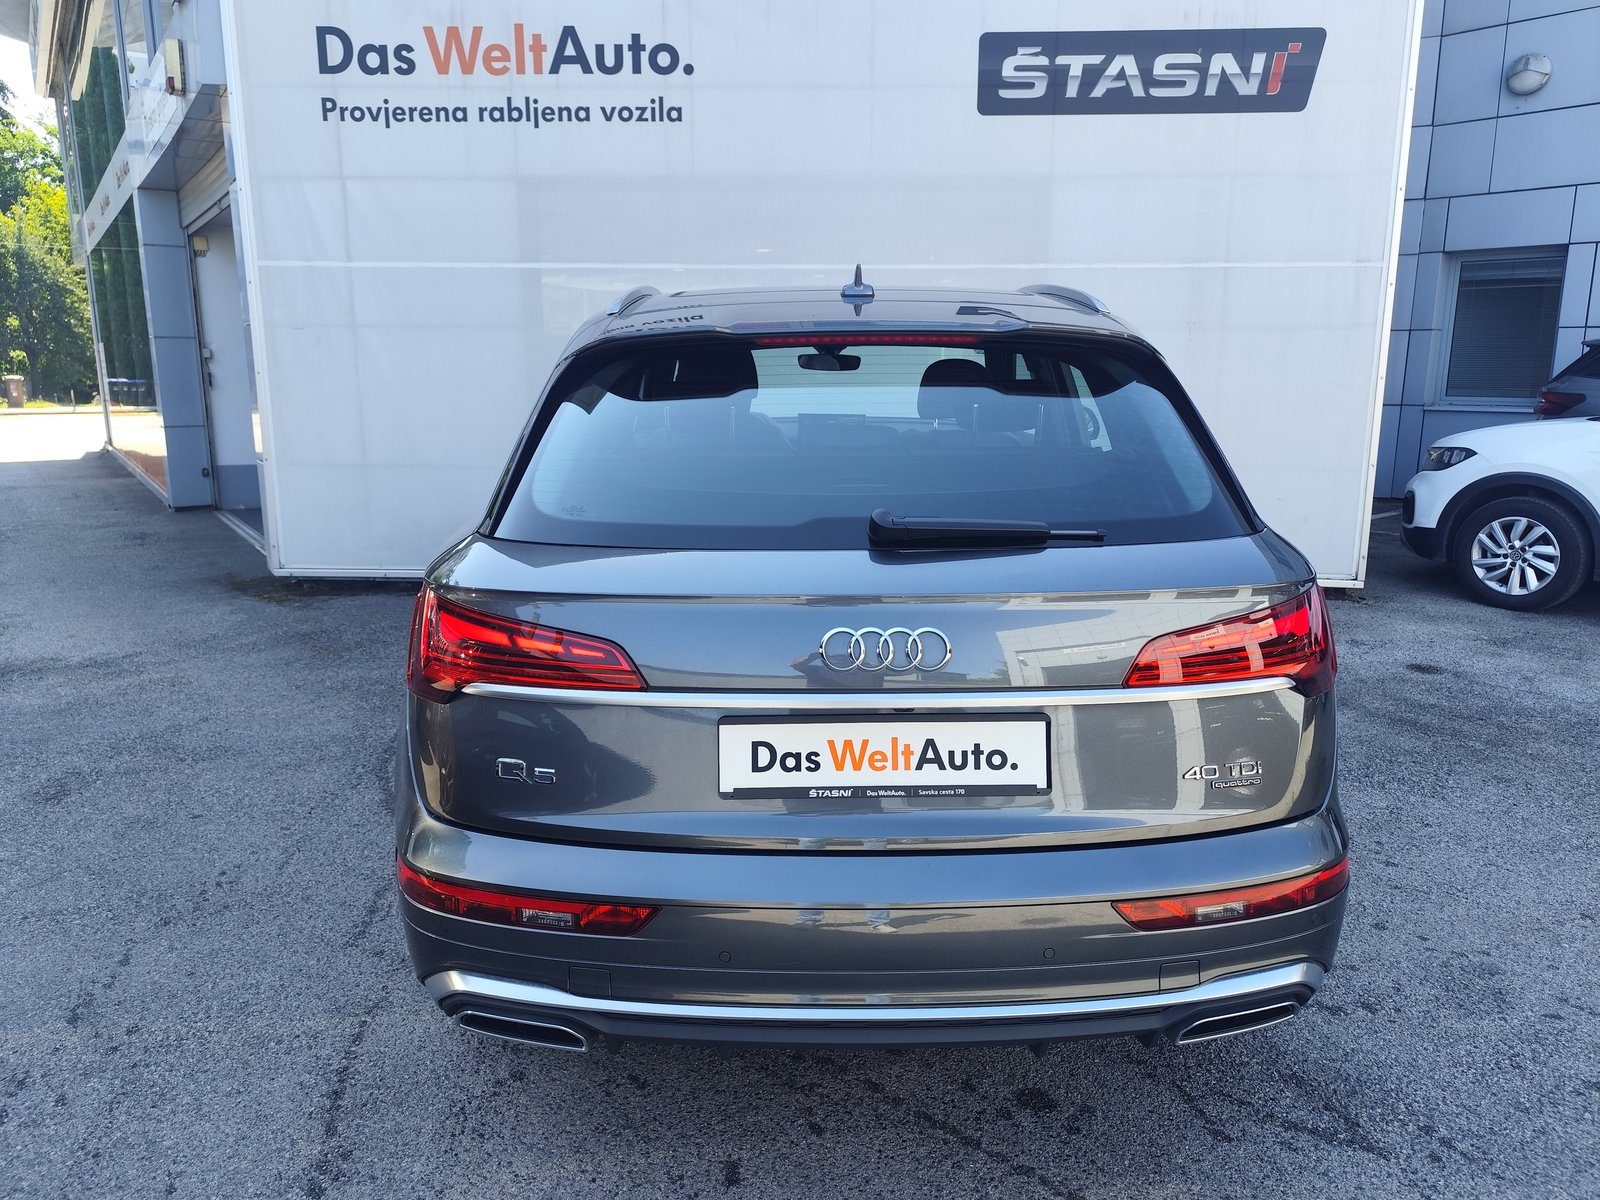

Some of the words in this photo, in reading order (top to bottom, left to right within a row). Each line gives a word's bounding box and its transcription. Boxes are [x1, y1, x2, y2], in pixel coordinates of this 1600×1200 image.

[315, 25, 416, 76] Das
[423, 23, 695, 76] WeltAuto.
[320, 96, 468, 128] Provjerena
[478, 96, 591, 128] rabljena
[600, 96, 683, 123] vozila
[751, 740, 821, 773] Das
[827, 736, 1019, 772] WeltAuto.
[496, 757, 556, 785] Q5
[1183, 765, 1219, 780] 40
[1214, 778, 1261, 789] quattro
